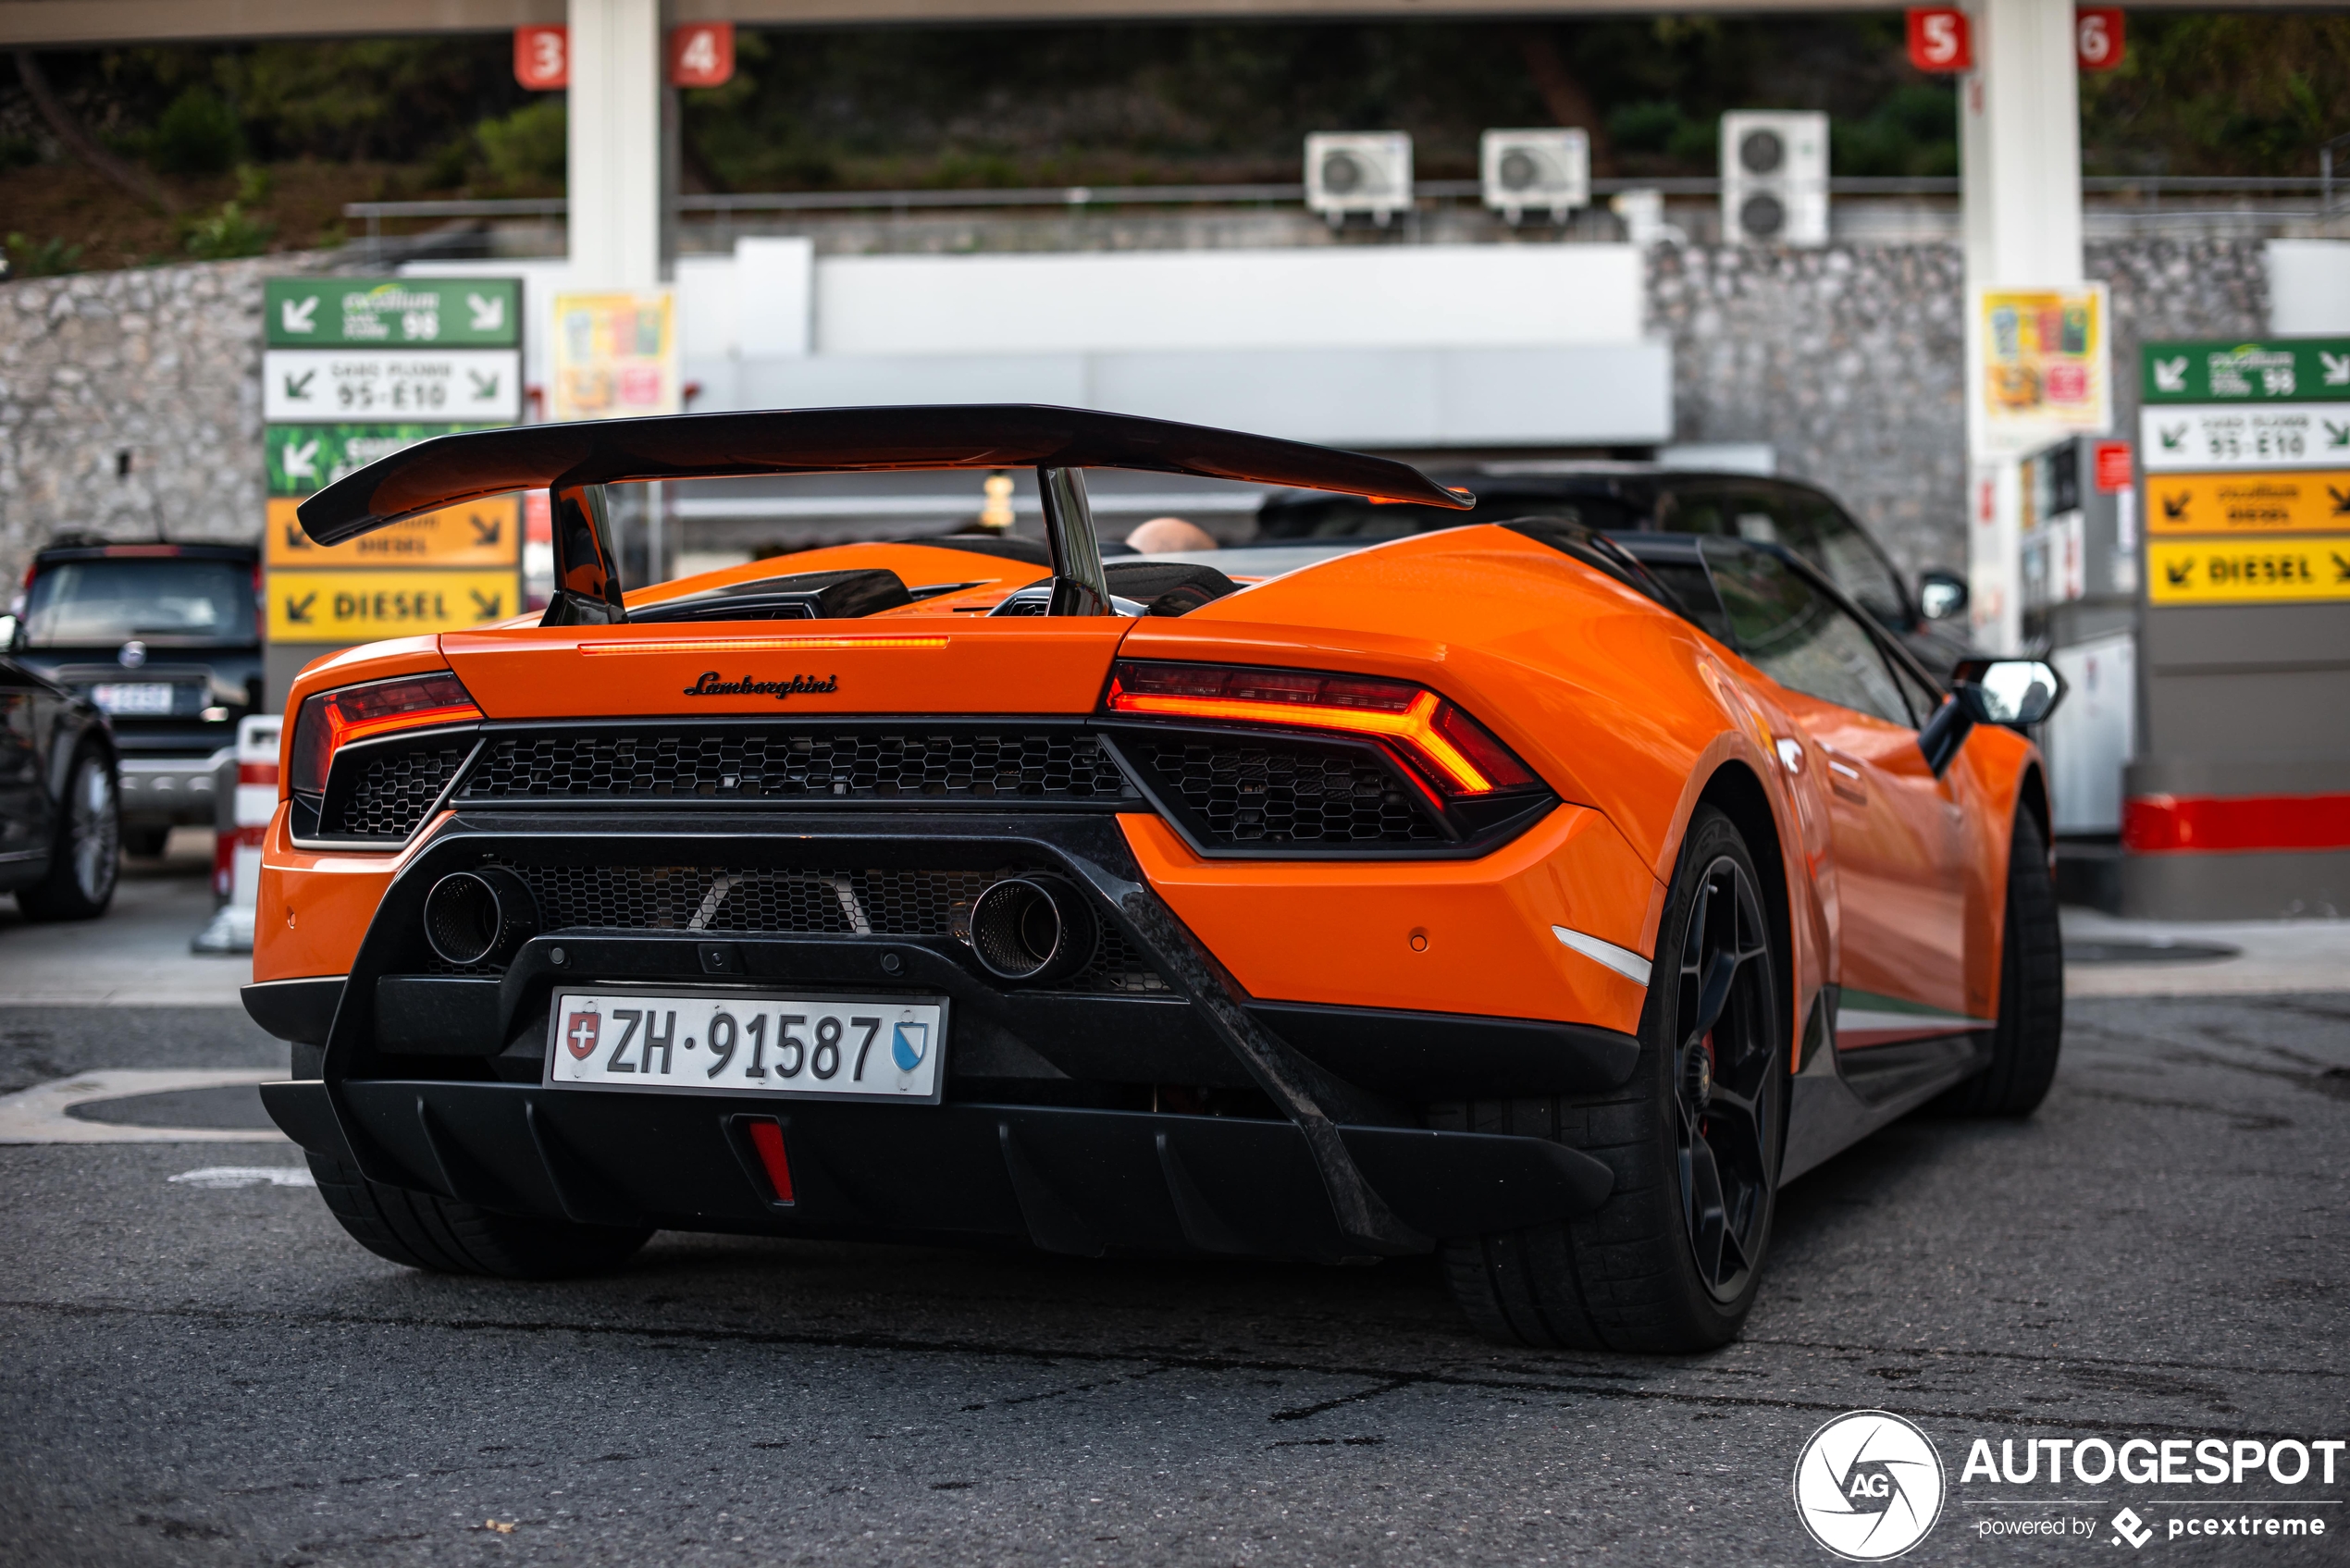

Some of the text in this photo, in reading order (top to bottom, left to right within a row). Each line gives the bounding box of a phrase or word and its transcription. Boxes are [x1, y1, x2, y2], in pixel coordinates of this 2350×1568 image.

[532, 31, 563, 80] 3
[680, 30, 717, 76] 4
[1923, 14, 1959, 64] 5
[2080, 15, 2110, 63] 6
[402, 311, 439, 340] 98
[2208, 555, 2316, 584] DIESEL
[334, 592, 450, 620] DIESEL
[683, 670, 837, 699] Lamborghini
